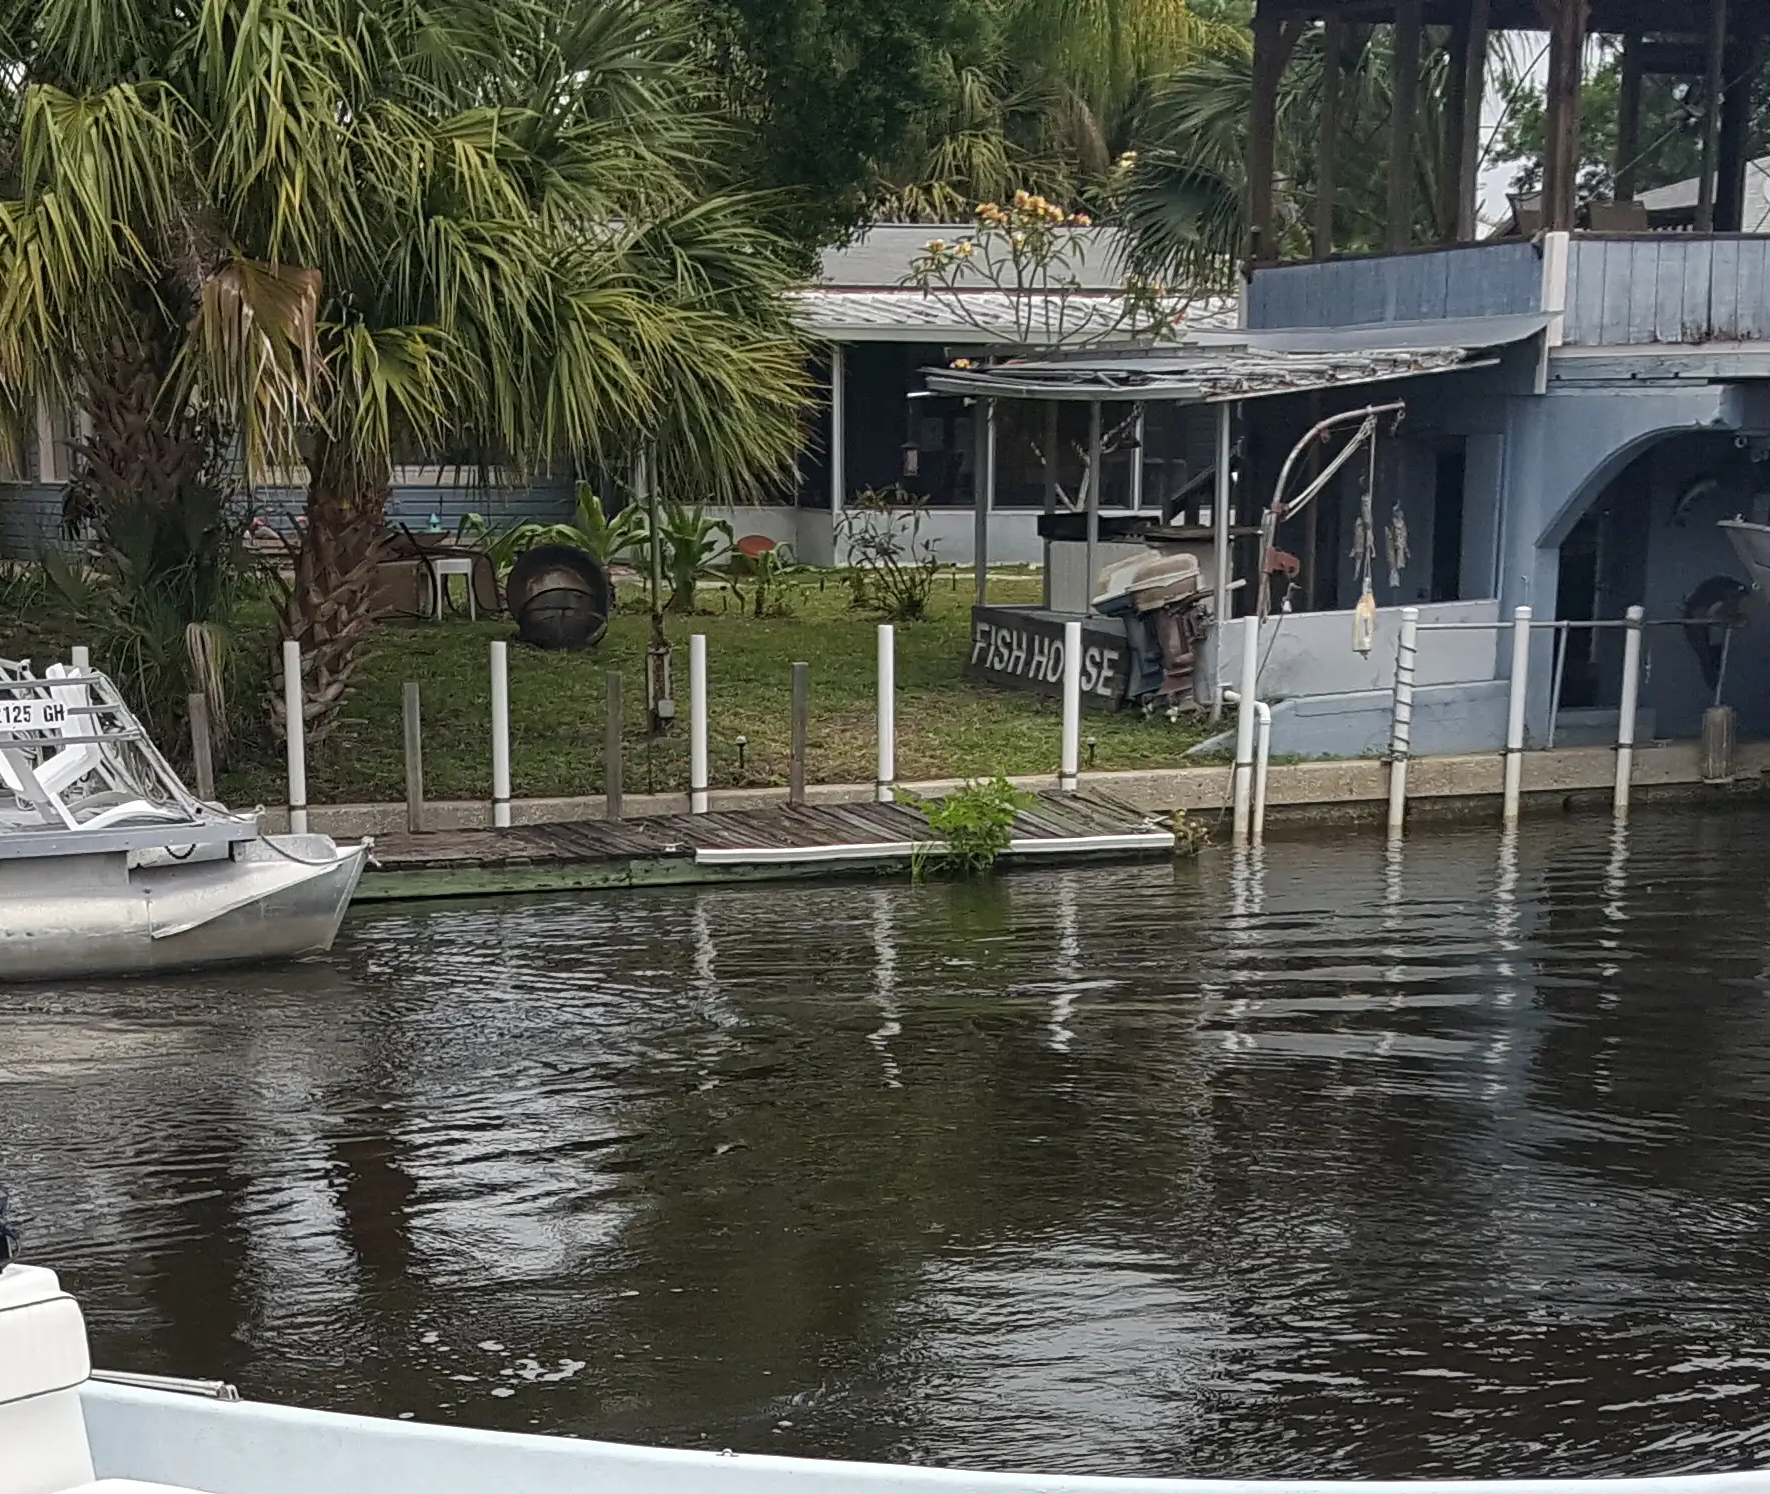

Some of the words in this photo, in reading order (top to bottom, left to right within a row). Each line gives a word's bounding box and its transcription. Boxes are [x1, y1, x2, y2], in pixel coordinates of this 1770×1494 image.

[971, 621, 1027, 676] FISH
[1029, 634, 1119, 697] HOSE
[43, 703, 66, 723] GH
